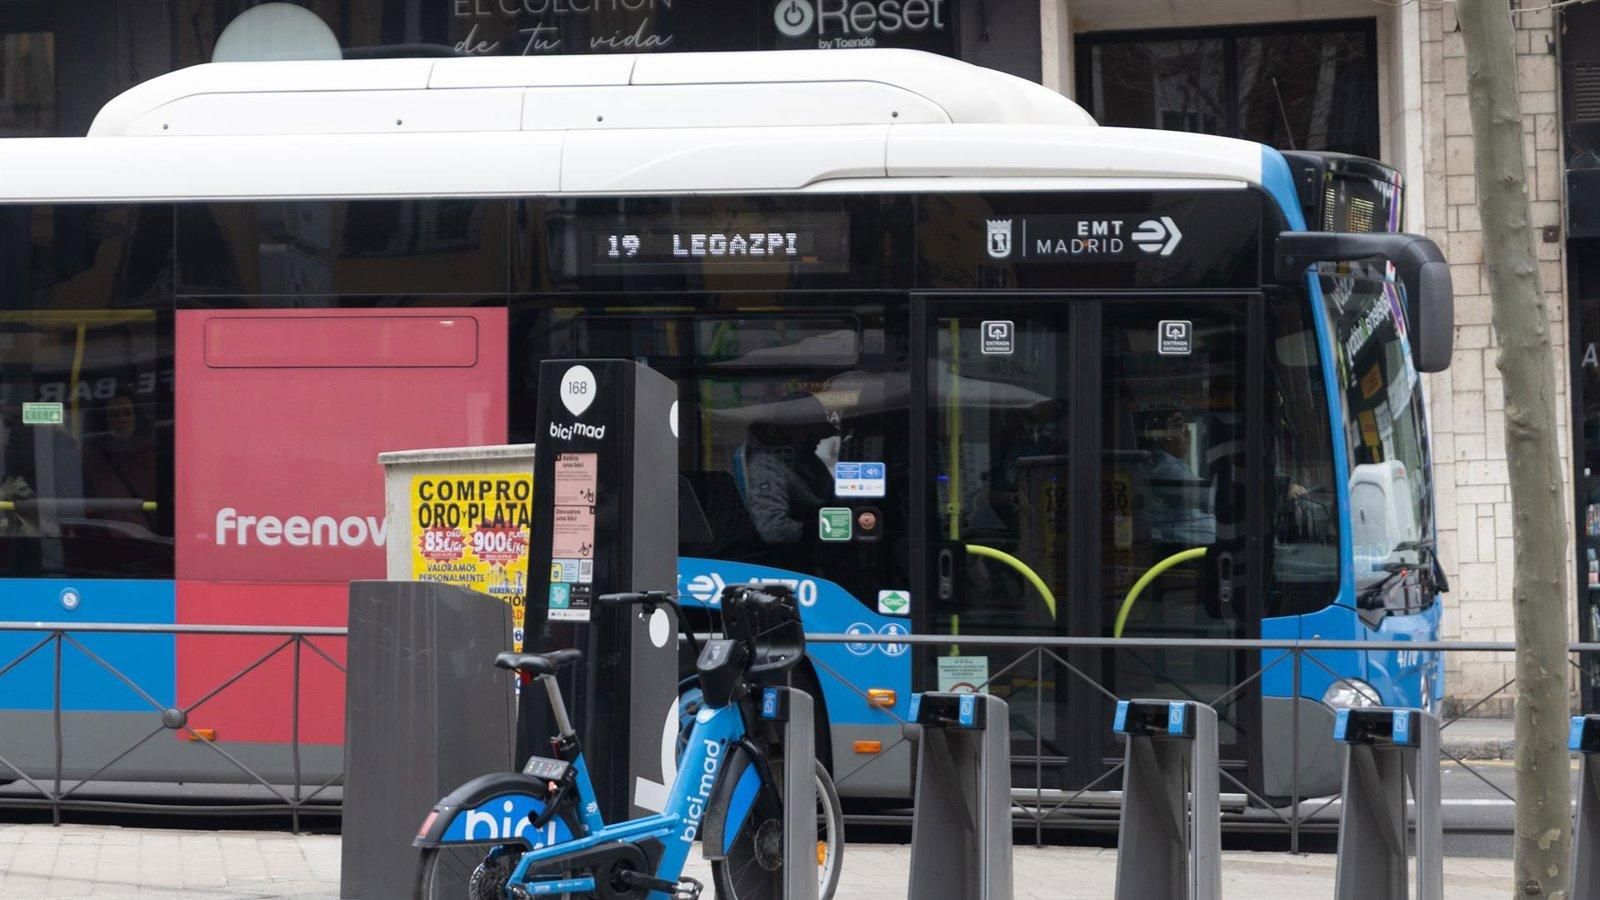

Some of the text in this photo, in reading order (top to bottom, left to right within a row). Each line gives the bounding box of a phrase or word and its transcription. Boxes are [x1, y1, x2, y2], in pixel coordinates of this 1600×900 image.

[454, 0, 490, 16] EL
[817, 0, 944, 35] Reset
[454, 24, 499, 54] de
[590, 18, 673, 49] vida
[818, 39, 832, 49] by
[1077, 221, 1124, 236] EMT
[608, 232, 797, 256] 19 LEGAZPI
[1036, 238, 1124, 254] MADRID
[568, 381, 587, 395] 168
[419, 480, 530, 501] COMPRO
[418, 502, 460, 528] ORO
[468, 502, 531, 528] PLATA
[427, 563, 477, 573] VALORAMOS
[418, 573, 485, 582] PERSONALMENTE
[488, 585, 525, 594] HERENCIAS
